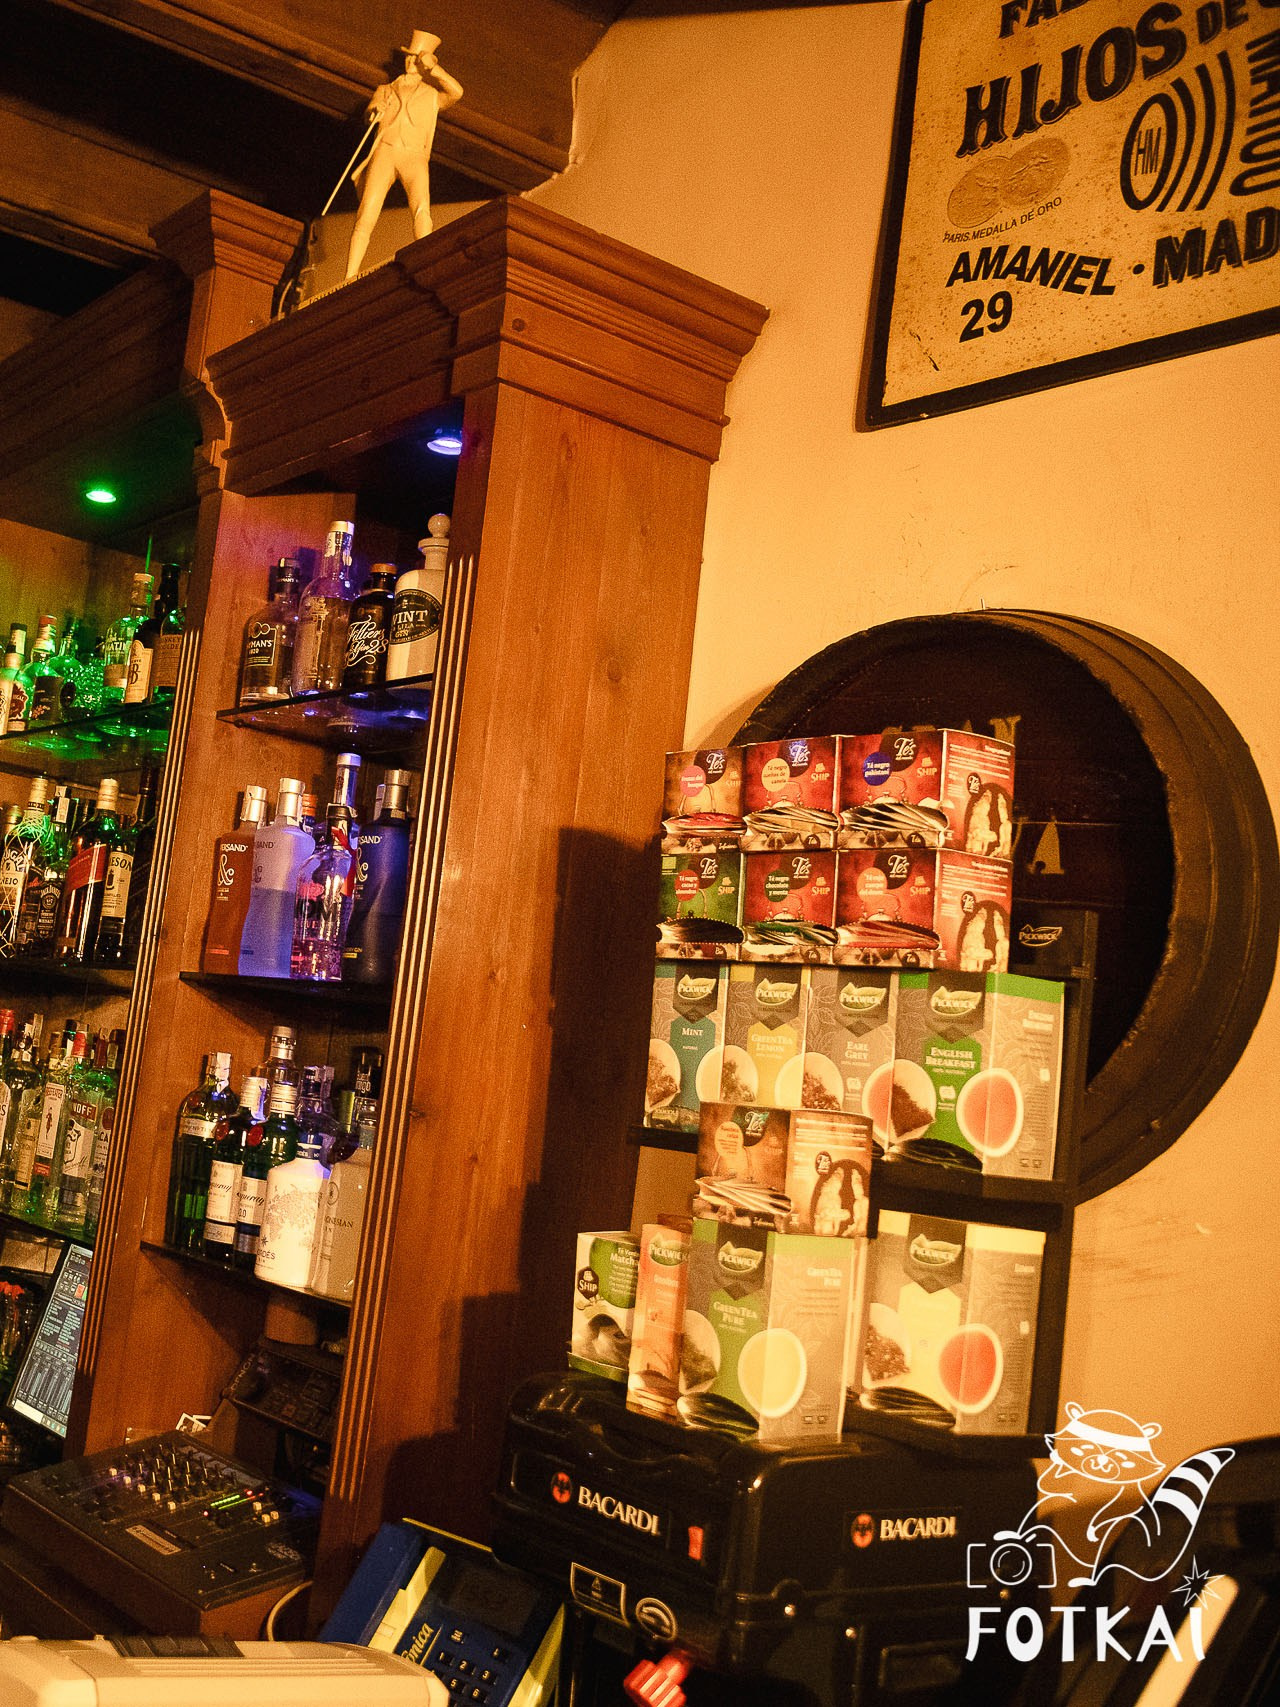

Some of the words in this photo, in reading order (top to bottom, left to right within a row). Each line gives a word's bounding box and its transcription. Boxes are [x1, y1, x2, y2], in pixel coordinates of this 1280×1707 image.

[955, 3, 1187, 158] HIJOS
[1020, 209, 1035, 225] DE
[1037, 197, 1062, 216] ORO
[945, 245, 1116, 296] AMANIEL
[959, 291, 1013, 343] 29
[894, 738, 917, 756] Tés
[917, 768, 937, 778] SHIP
[811, 772, 830, 782] SHIP
[700, 857, 718, 875] Tés
[718, 886, 735, 896] SHIP
[792, 857, 811, 875] Tés
[811, 886, 830, 896] SHIP
[887, 855, 909, 874] Tés
[910, 887, 931, 896] SHIP
[678, 983, 713, 994] PICKWICK
[756, 988, 793, 1000] PICKWICK
[839, 992, 882, 1005] PICKWICK
[932, 997, 977, 1010] PICKWICK
[682, 1028, 704, 1037] MINT
[844, 1050, 868, 1060] GREY
[930, 1047, 973, 1059] ENGLISH
[925, 1056, 976, 1069] BREAKFAST
[649, 1244, 688, 1262] PICKWICK
[718, 1252, 758, 1268] PICKWICK
[578, 1280, 598, 1293] SHIP
[577, 1486, 660, 1535] BACARDI
[880, 1515, 957, 1541] BACARDI
[459, 1660, 467, 1669] 2
[482, 1670, 490, 1680] 3
[450, 1679, 457, 1688] 5
[472, 1688, 480, 1697] 6
